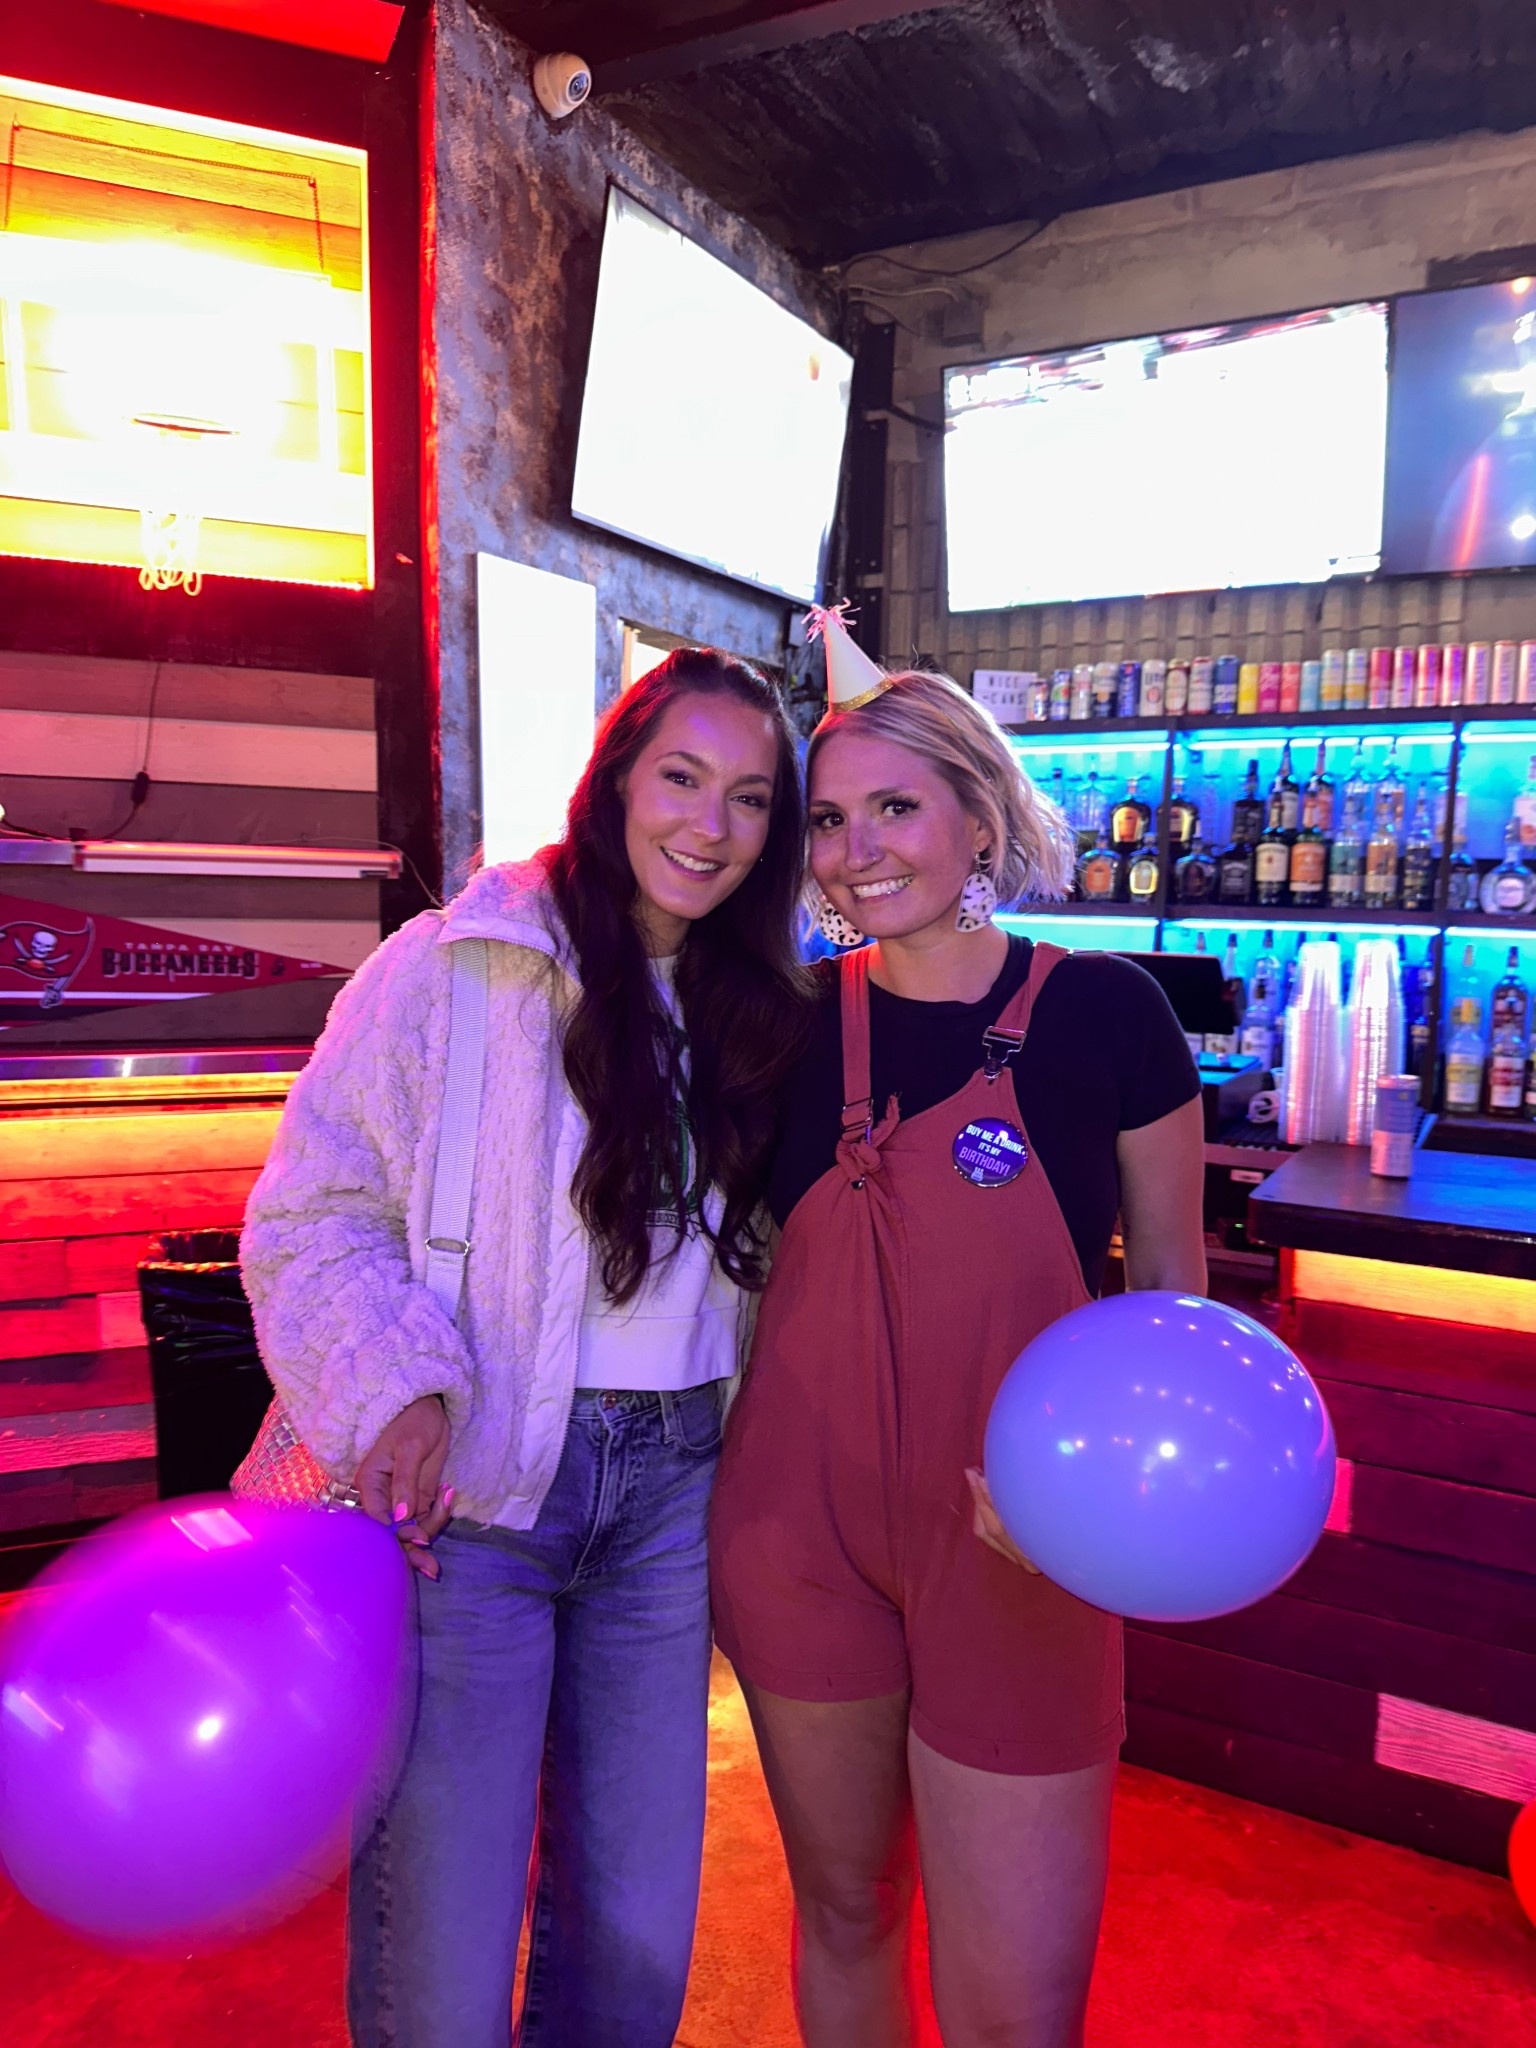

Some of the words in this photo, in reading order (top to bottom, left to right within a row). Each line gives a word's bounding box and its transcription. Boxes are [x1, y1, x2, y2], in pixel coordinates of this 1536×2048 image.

[124, 942, 189, 952] TAMPA
[198, 944, 235, 952] BAY
[102, 947, 260, 983] BUCCANEERS
[965, 1124, 983, 1138] BUY
[980, 1130, 995, 1142] ME
[1000, 1137, 1025, 1155] DRINK
[978, 1141, 992, 1153] IT'S
[989, 1146, 1002, 1157] MY
[958, 1146, 1011, 1177] BIRTHDAY!
